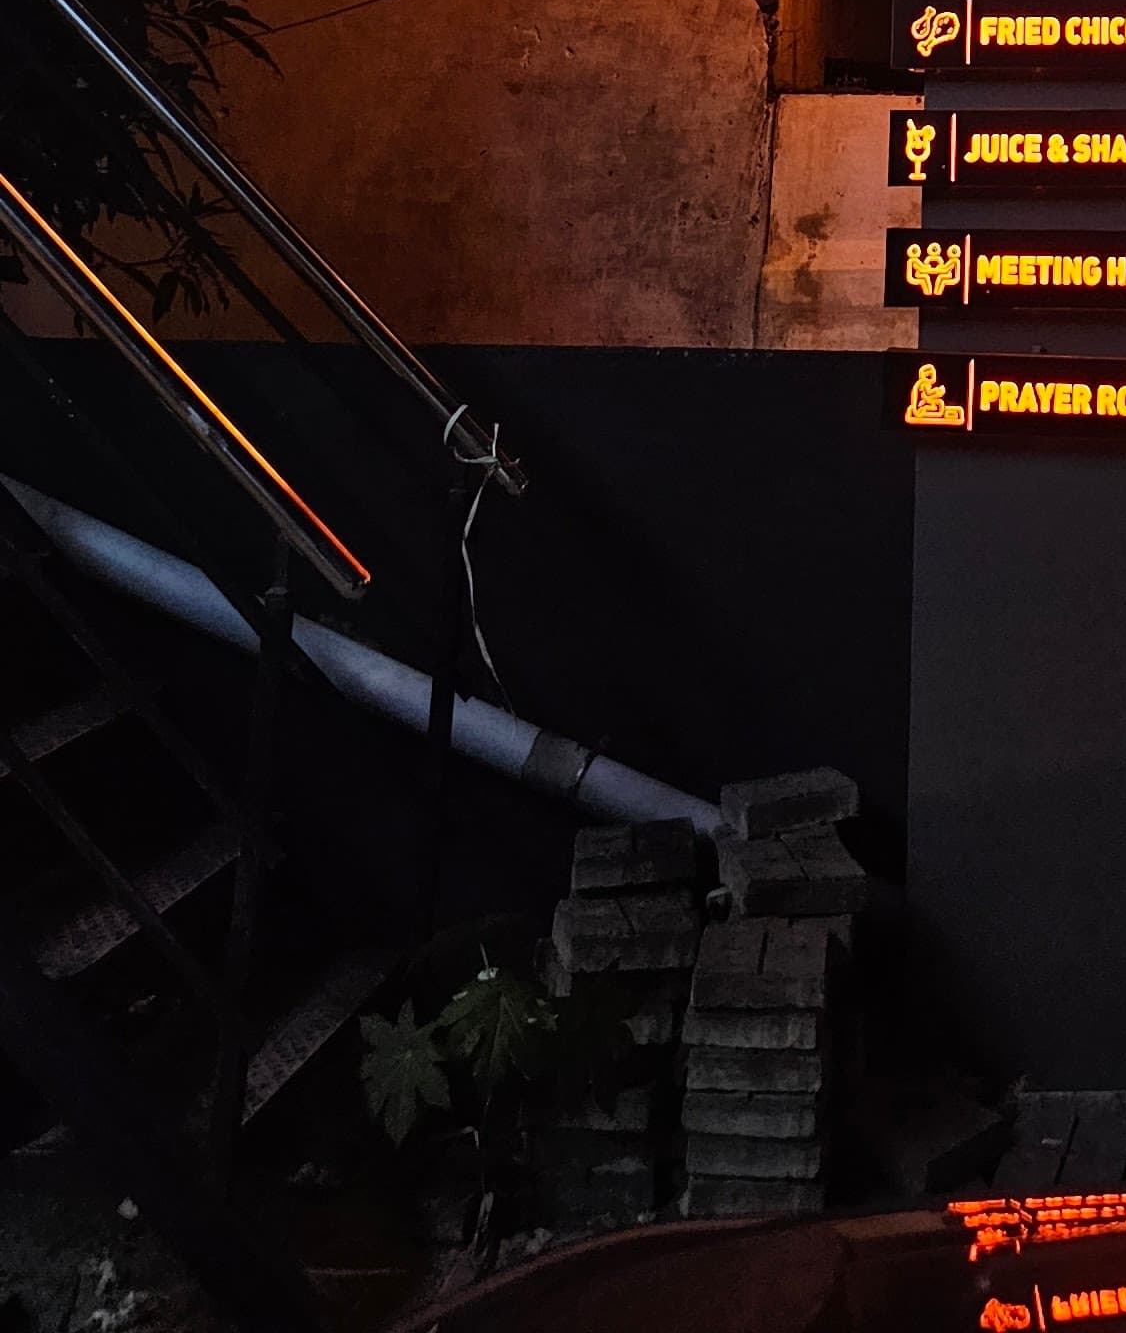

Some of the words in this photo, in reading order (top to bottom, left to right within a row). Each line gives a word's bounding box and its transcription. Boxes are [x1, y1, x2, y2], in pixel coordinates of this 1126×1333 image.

[979, 16, 1061, 46] FRIED
[963, 133, 1043, 164] JUICE
[1046, 133, 1070, 164] &
[976, 254, 1103, 287] MEETING
[979, 380, 1093, 415] PRAYER
